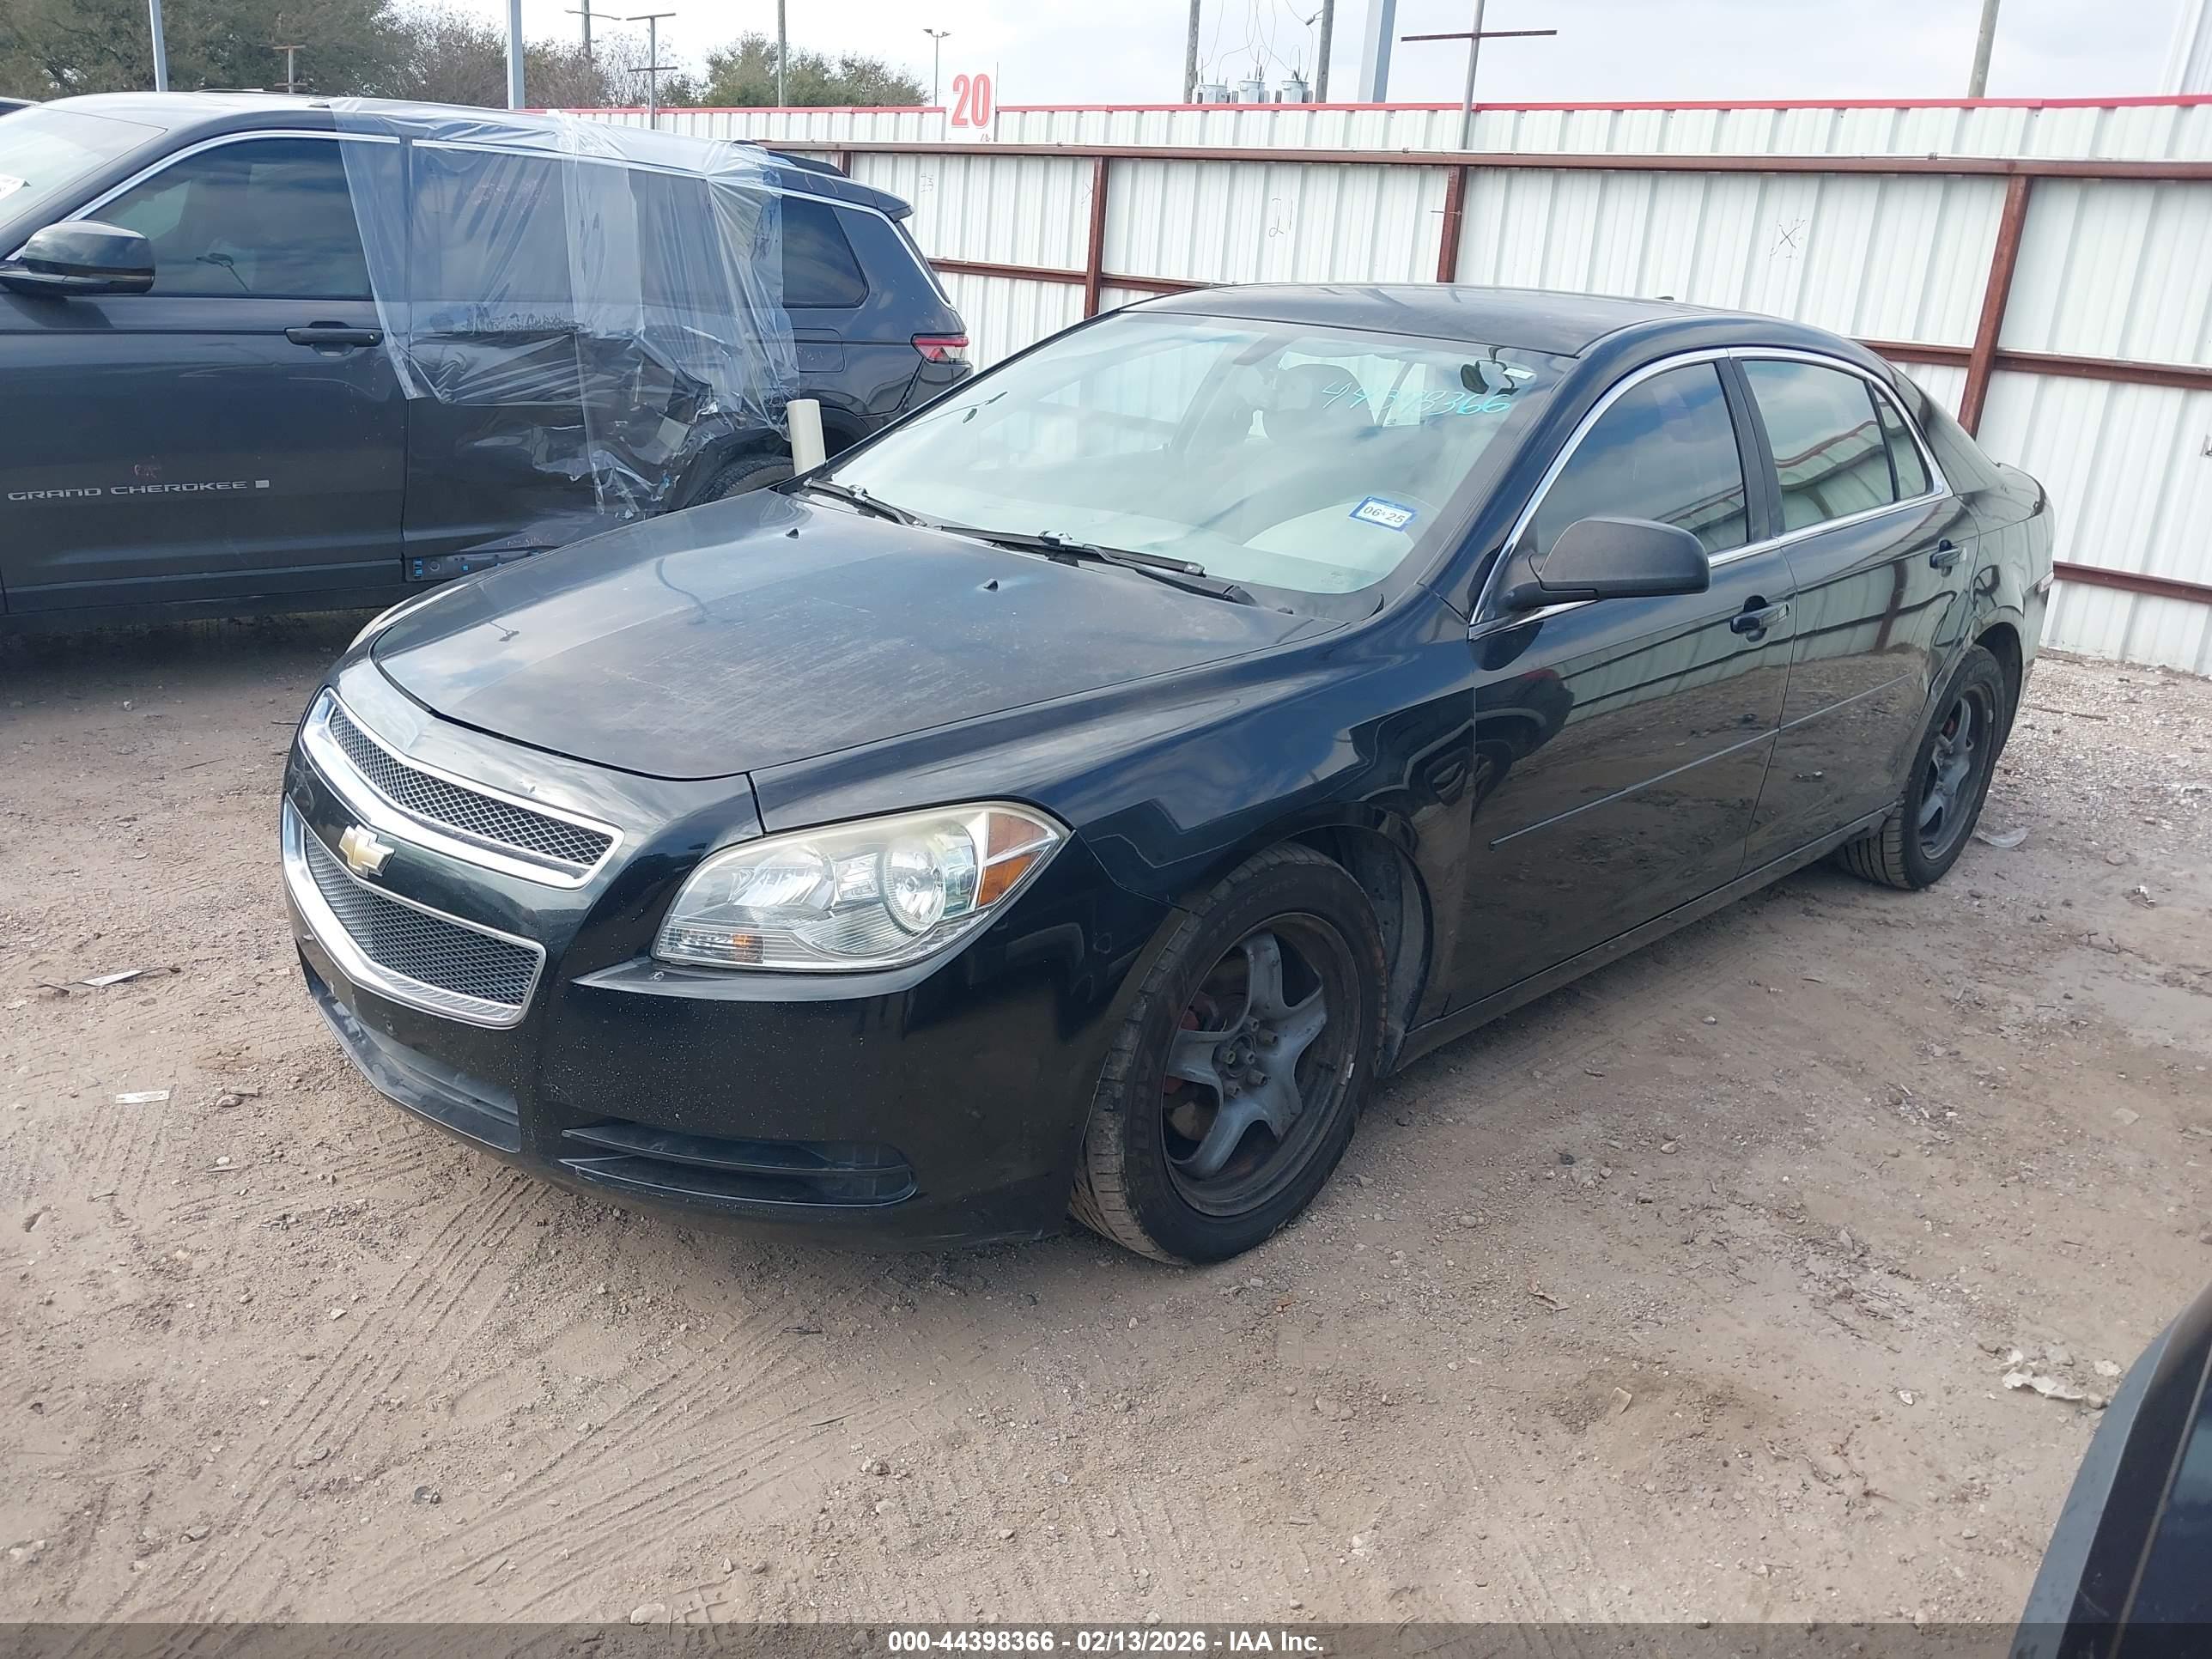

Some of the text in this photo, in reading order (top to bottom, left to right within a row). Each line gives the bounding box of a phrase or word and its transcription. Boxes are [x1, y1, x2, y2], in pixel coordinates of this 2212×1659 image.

[951, 74, 991, 129] 20
[7, 480, 248, 501] GRAND CHEROKEE
[1363, 505, 1406, 523] 06 25
